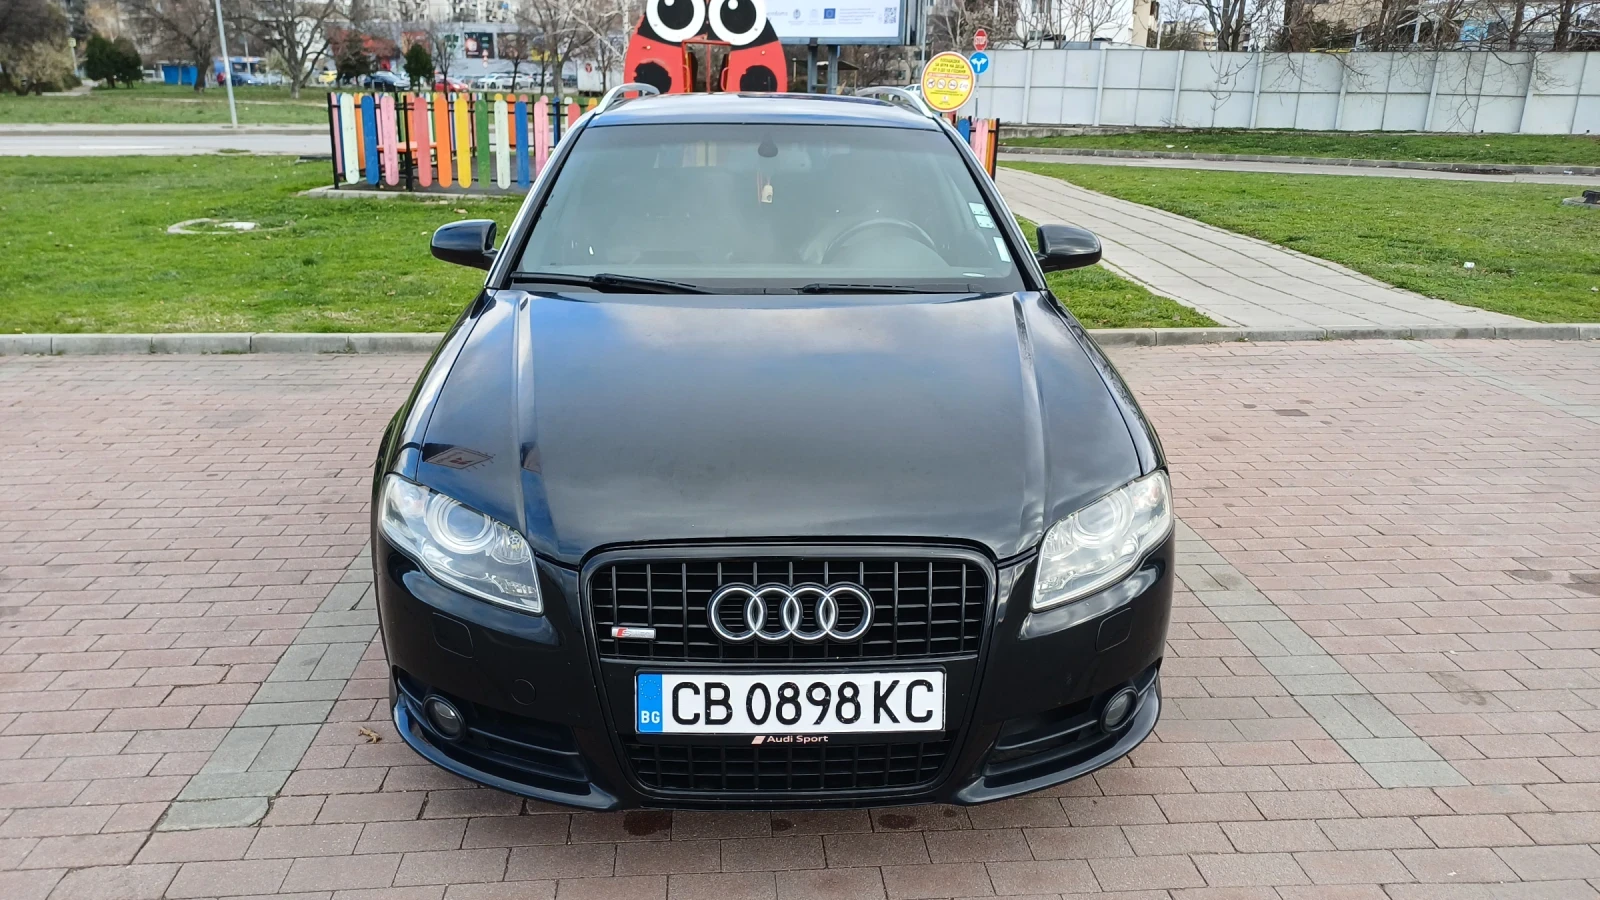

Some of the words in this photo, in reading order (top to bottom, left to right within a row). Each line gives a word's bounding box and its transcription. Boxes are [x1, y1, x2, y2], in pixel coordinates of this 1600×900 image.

[672, 682, 733, 725] CB
[746, 682, 861, 725] 0898
[873, 680, 934, 724] KC
[641, 710, 660, 724] BG
[767, 735, 793, 743] Audi
[796, 735, 829, 745] Sport
